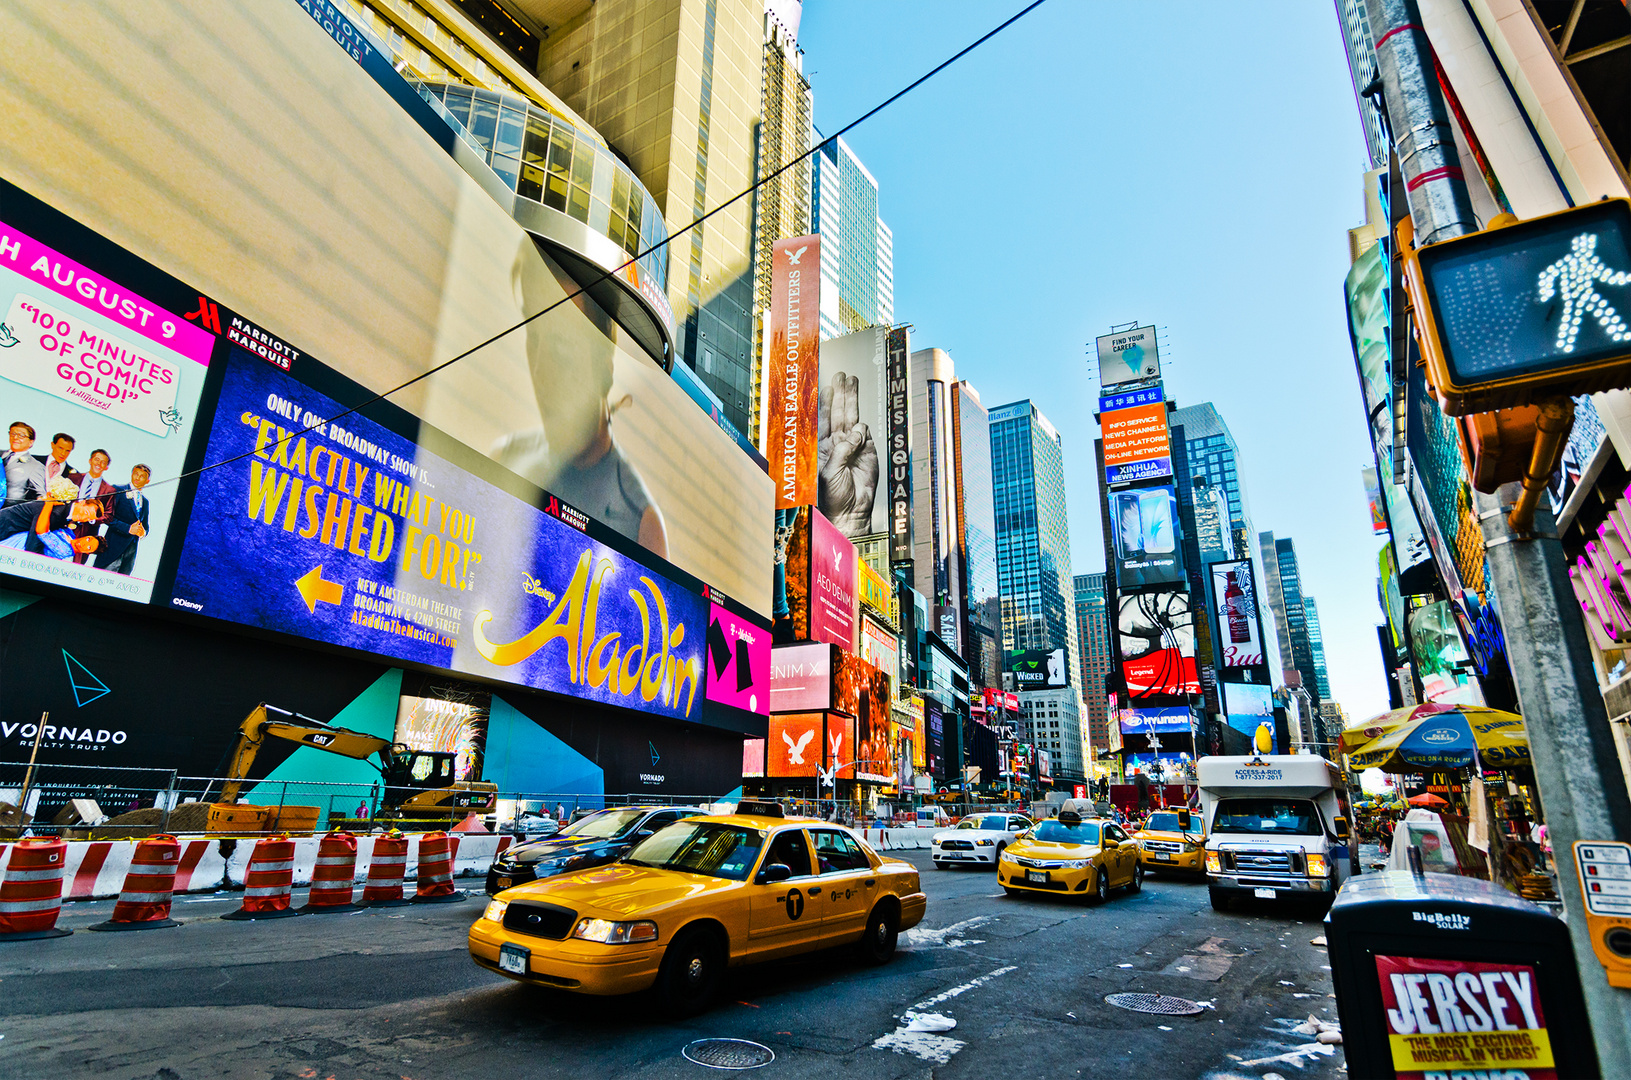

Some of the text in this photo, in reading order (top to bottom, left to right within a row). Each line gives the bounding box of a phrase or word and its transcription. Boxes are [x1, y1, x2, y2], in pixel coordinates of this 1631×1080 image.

[301, 0, 360, 61] ARQUIS
[316, 0, 372, 56] RRIOTT
[31, 255, 177, 339] AUGUST 9
[20, 302, 173, 385] "100 MINUTES
[231, 317, 300, 362] MARRIOTT
[1112, 334, 1145, 346] FIND YOUR
[1113, 343, 1137, 352] CAREER
[229, 329, 290, 370] MARQUIS
[39, 334, 153, 396] OF COMIC
[56, 362, 139, 404] GOLD!"
[783, 270, 801, 503] AMERICAN EAGLE OUTFITTERS
[1105, 392, 1158, 408] 新华通讯社
[988, 411, 1011, 421] llianz
[1109, 416, 1158, 429] INFO SERVICE
[267, 393, 436, 488] ONLY ONE BROADWAY SHOW IS...
[1105, 424, 1166, 439] NEWS CHANNELS
[890, 348, 908, 535] TIMES SQUARE
[1105, 435, 1166, 450] MEDIA PLATFORM
[1105, 445, 1170, 460] ON-LINE NETWORK
[1112, 467, 1167, 482] NEWS AGENCY
[1119, 461, 1158, 474] XINHUA
[241, 412, 476, 545] "EXACTLY WHAT YOU
[561, 512, 586, 531] MARQUIS
[562, 504, 590, 524] MARRIOTT
[248, 460, 482, 592] WISHED FOR!"
[19, 559, 87, 582] BROADWAY
[356, 577, 462, 621] NEW AMSTERDAM THEATRE
[522, 571, 556, 608] Disney
[816, 571, 831, 593] AEO
[832, 583, 851, 608] DENIM
[172, 597, 204, 612] ©Disney
[353, 593, 462, 635] BROADWAY & 42ND STREET
[350, 610, 458, 648] AladdinTheMusical.com
[473, 548, 699, 718] Aladdin
[770, 661, 821, 681] ENIM X
[1130, 668, 1154, 676] Legend
[424, 698, 472, 717] INVICTA
[1143, 715, 1189, 725] HYUNDAI
[1, 721, 128, 745] VORNADO
[313, 734, 328, 746] CAT
[19, 740, 107, 751] RELTY TRUST
[1349, 748, 1395, 765] SABRET
[639, 773, 665, 782] VORNADO
[459, 798, 470, 807] CAT
[1412, 911, 1471, 925] BigBelly
[1436, 922, 1465, 930] SOLAR
[1387, 971, 1541, 1035] JERSEY
[1403, 1033, 1533, 1050] "THE MOST EXCITING
[1411, 1046, 1541, 1063] MUSICAL IN YEARS!"
